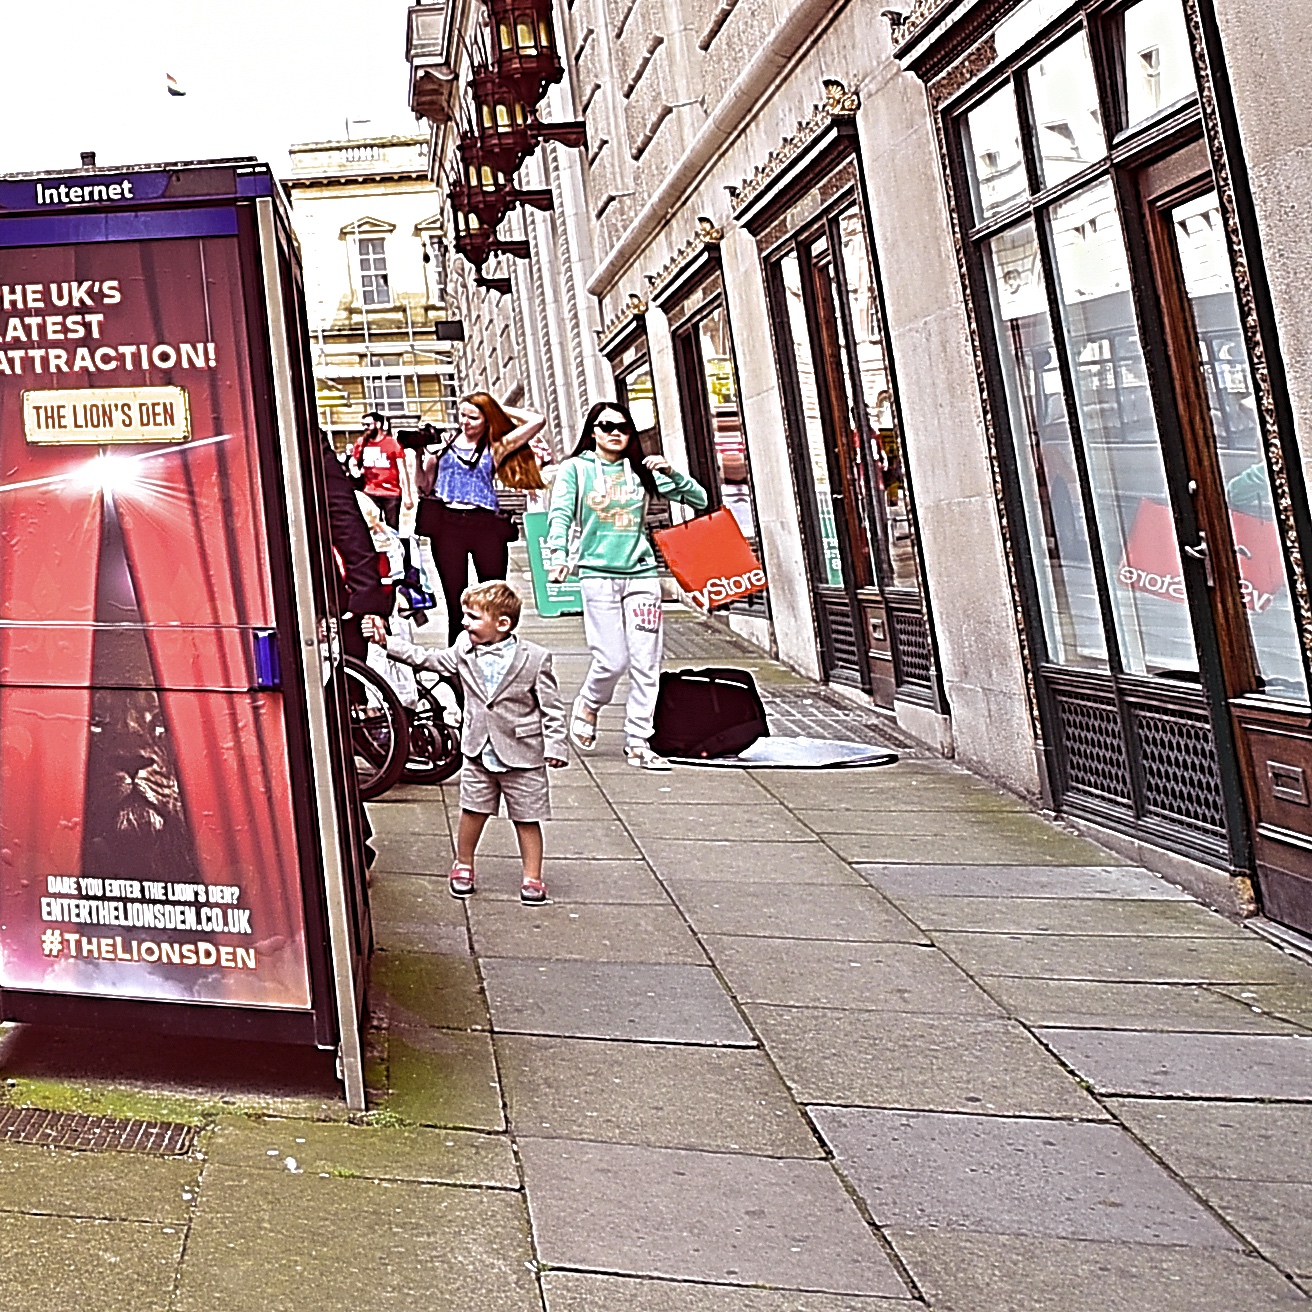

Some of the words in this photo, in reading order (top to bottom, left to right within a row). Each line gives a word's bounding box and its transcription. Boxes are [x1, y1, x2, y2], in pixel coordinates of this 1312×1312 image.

[36, 179, 134, 205] Internet
[50, 280, 123, 307] UK'S
[33, 406, 67, 430] THE
[74, 403, 133, 429] LION'S
[139, 401, 175, 427] DEN
[46, 875, 78, 895] DARE
[79, 877, 103, 897] YOU
[105, 879, 141, 899] ENTER
[143, 881, 166, 901] THE
[167, 882, 206, 903] LION'S
[208, 885, 240, 905] DEN?
[40, 896, 252, 934] ENTERTHELIONSDEN.CO.UK
